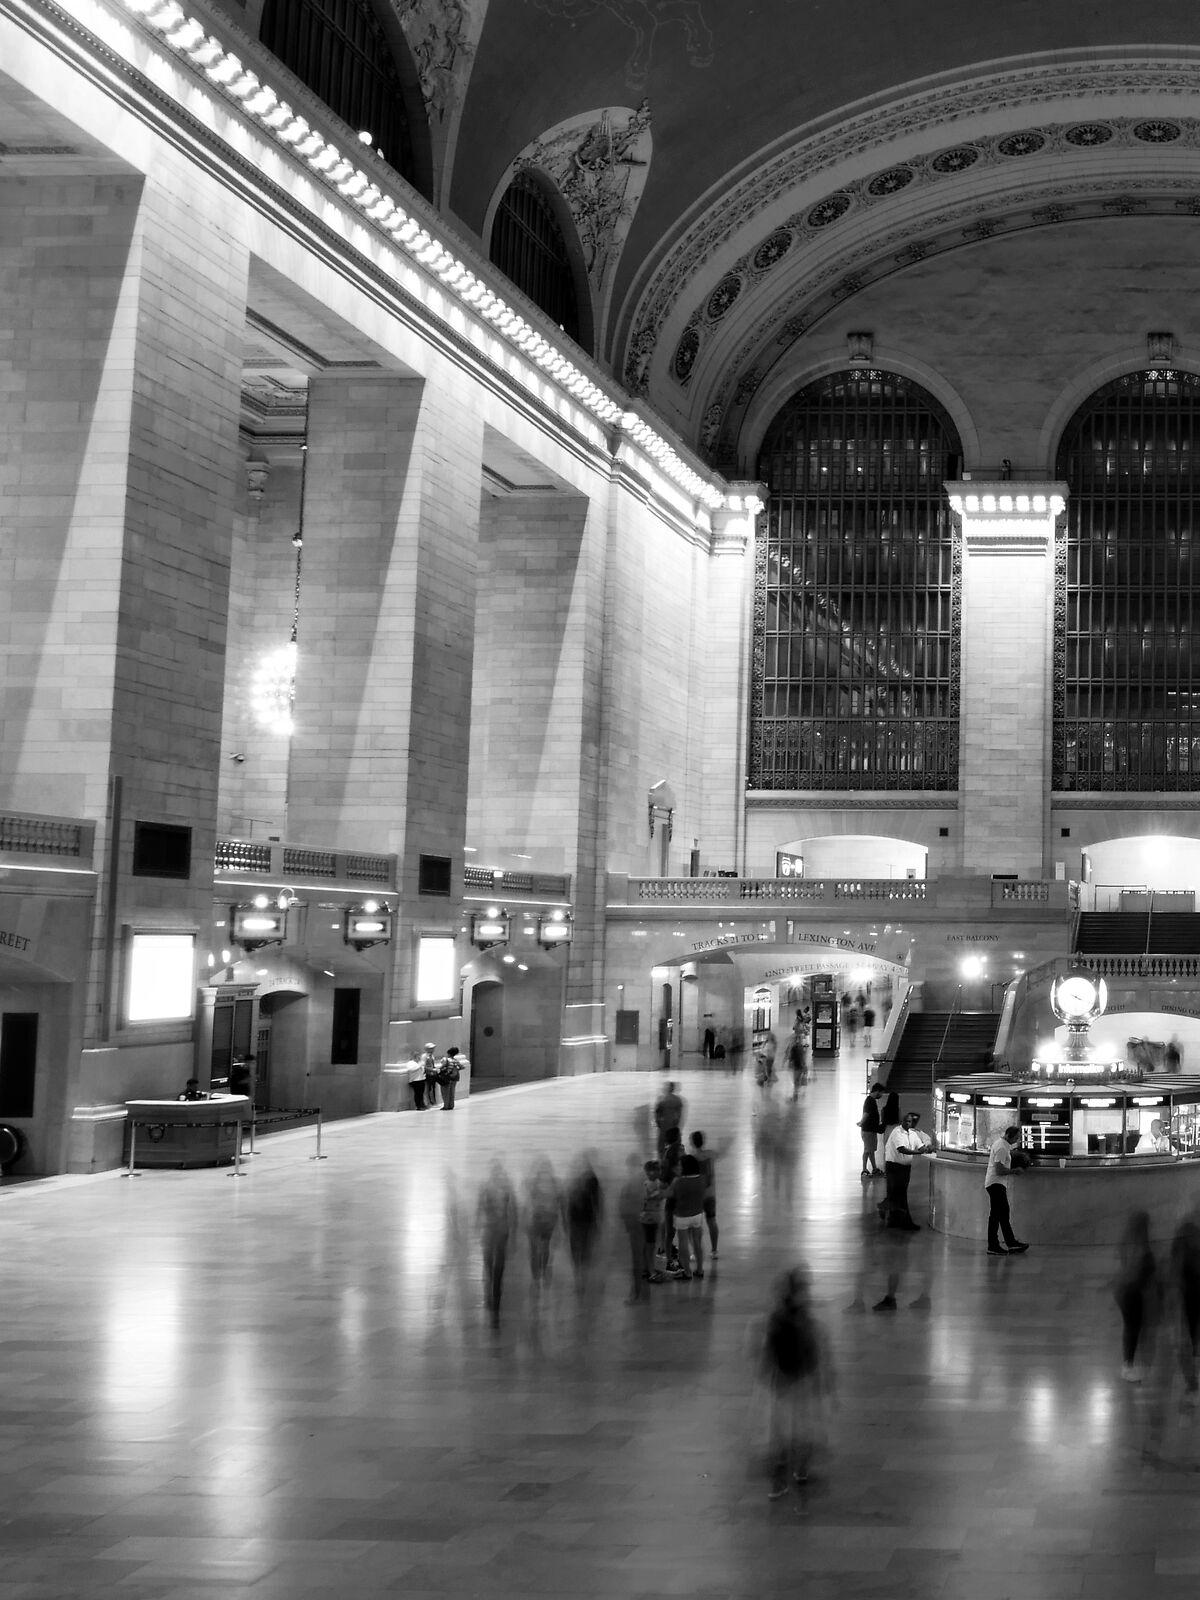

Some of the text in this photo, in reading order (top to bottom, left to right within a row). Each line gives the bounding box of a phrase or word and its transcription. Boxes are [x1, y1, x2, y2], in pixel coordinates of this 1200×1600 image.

[691, 936, 729, 951] TRACKS
[740, 934, 755, 942] TO
[798, 933, 877, 953] LEXINGTON AVE
[786, 964, 813, 974] STREET
[1161, 1004, 1187, 1014] DINING
[1058, 1063, 1104, 1073] Information
